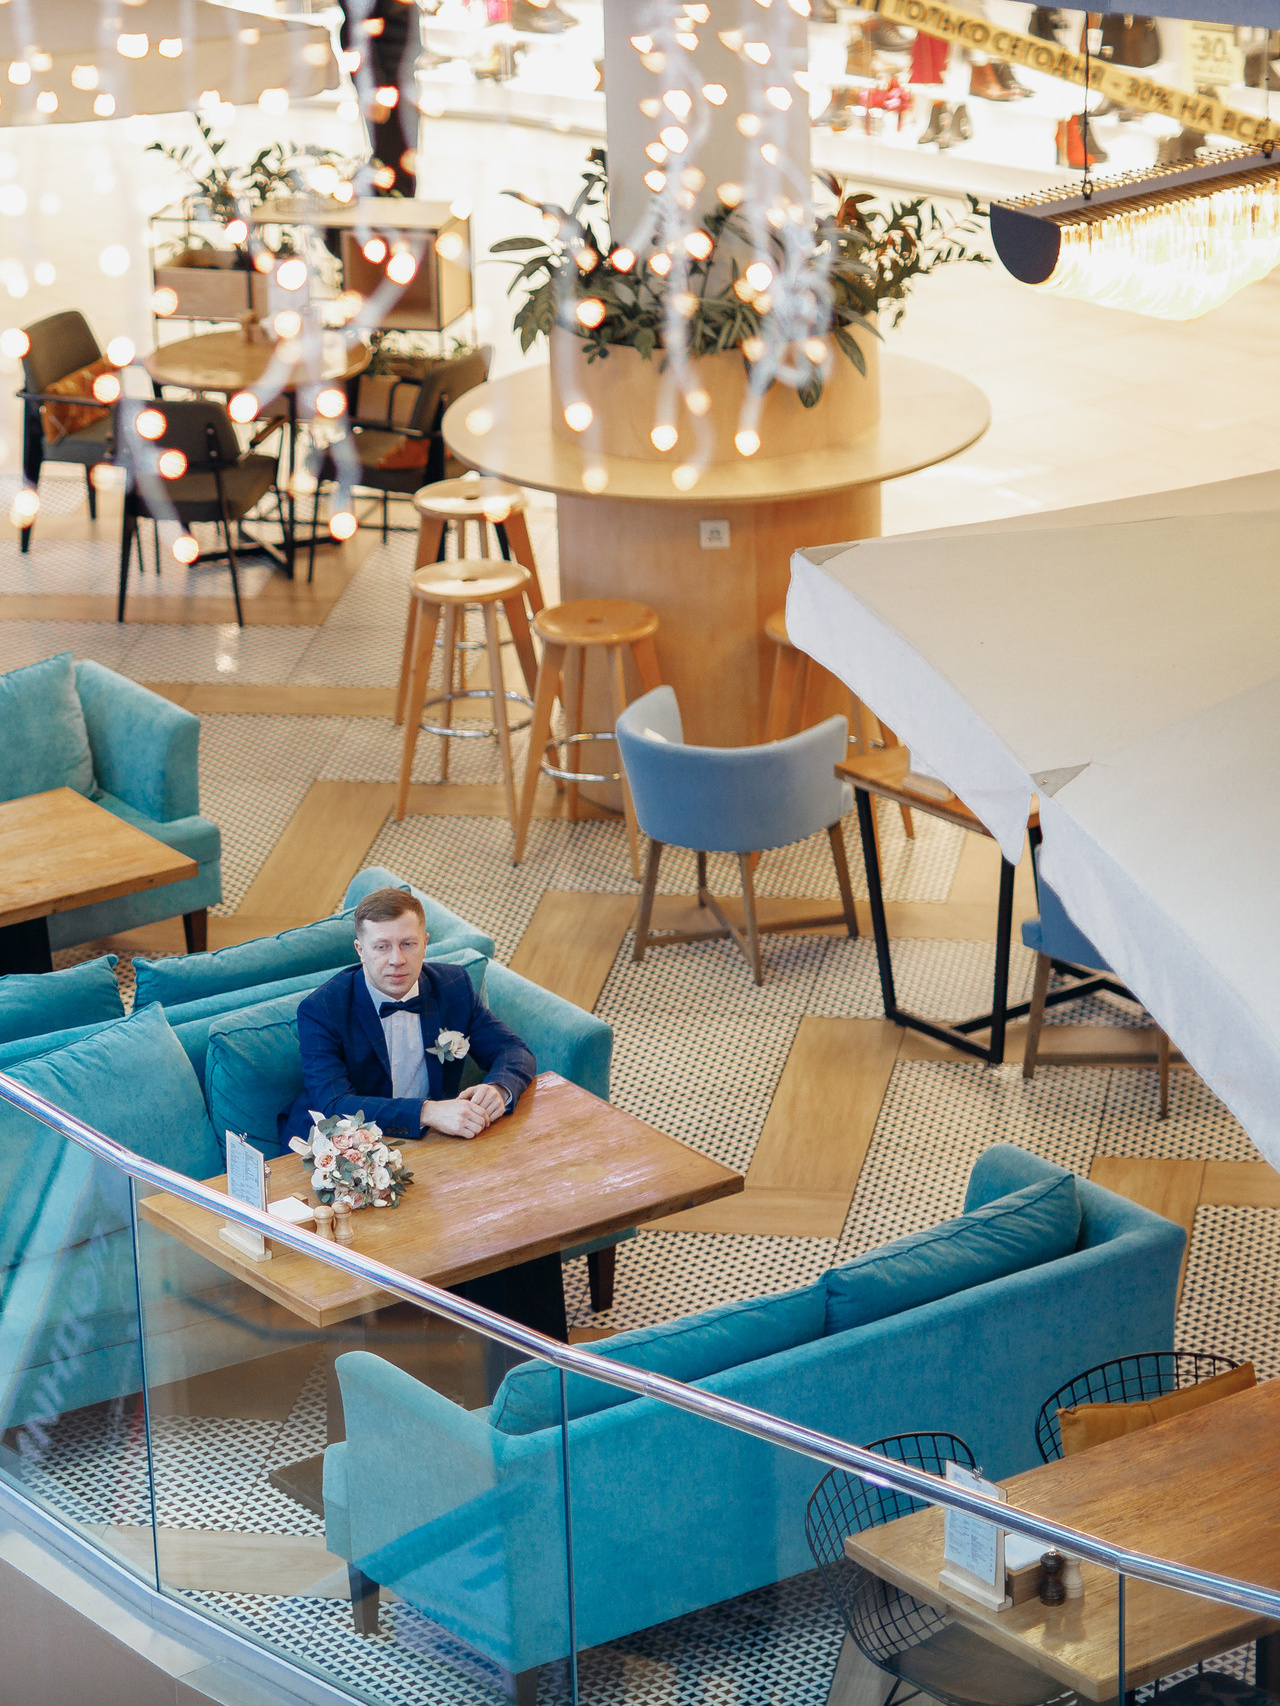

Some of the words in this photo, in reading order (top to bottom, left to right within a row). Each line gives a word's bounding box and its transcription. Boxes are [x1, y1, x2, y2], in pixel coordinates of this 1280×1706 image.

[893, 0, 989, 44] ТОЛЬКО
[993, 31, 1105, 83] СЕГОДНЯ
[1181, 99, 1214, 127] НА
